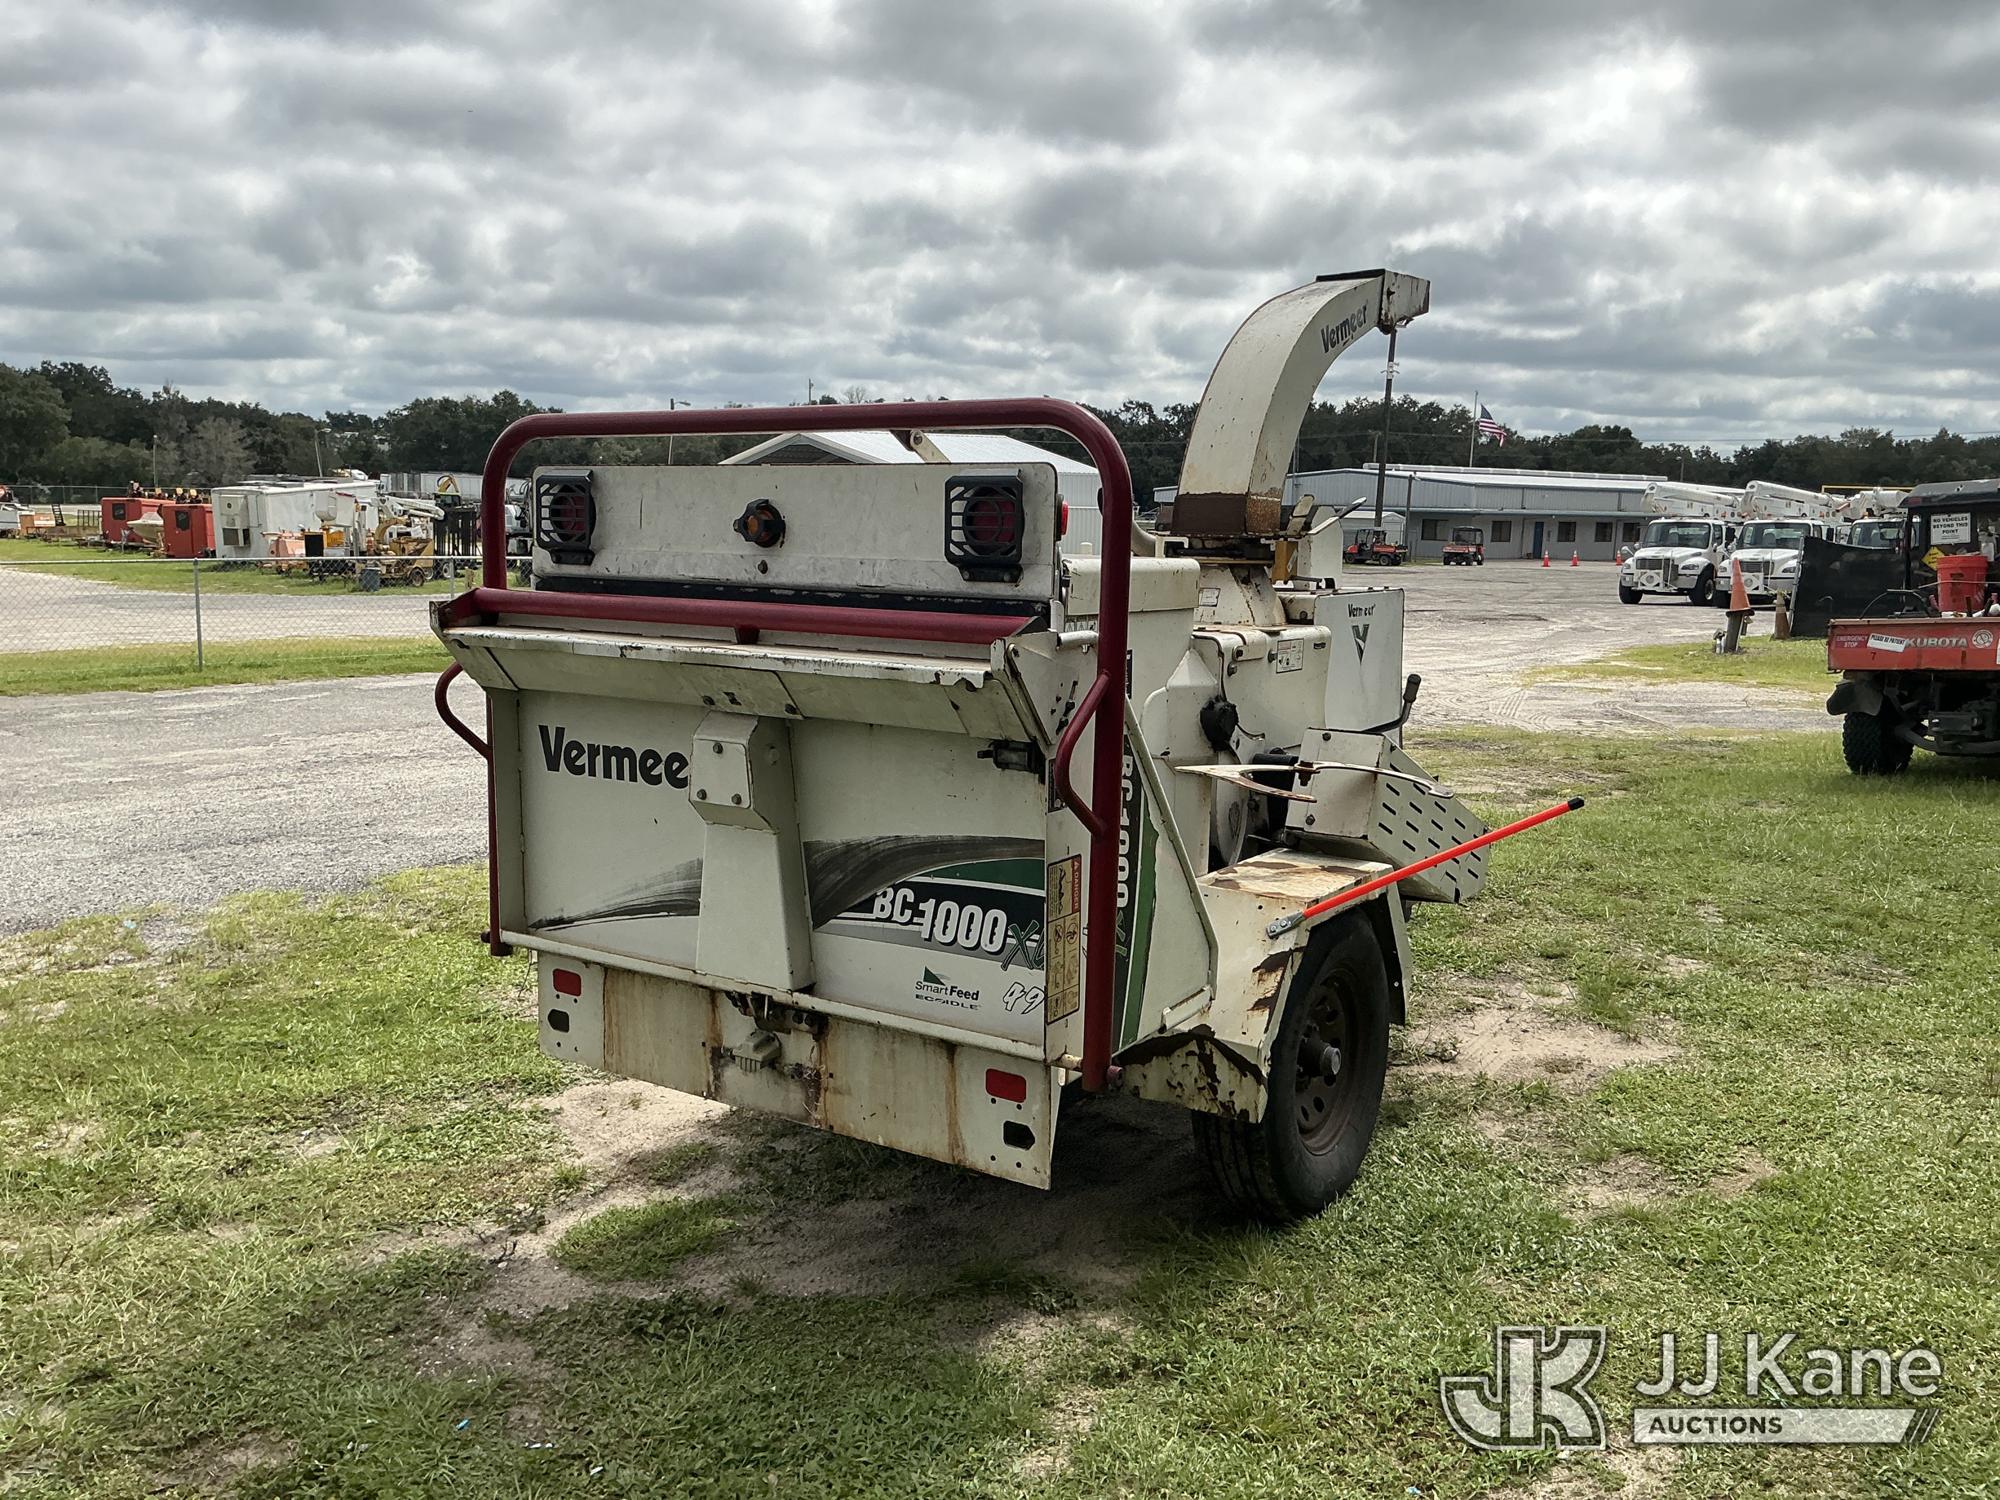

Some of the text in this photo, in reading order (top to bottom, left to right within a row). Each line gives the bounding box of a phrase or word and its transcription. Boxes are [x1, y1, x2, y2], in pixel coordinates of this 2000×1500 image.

[1321, 305, 1367, 354] Vermeer
[1348, 603, 1376, 618] Vermeer
[1906, 636, 1968, 649] KUBOTA
